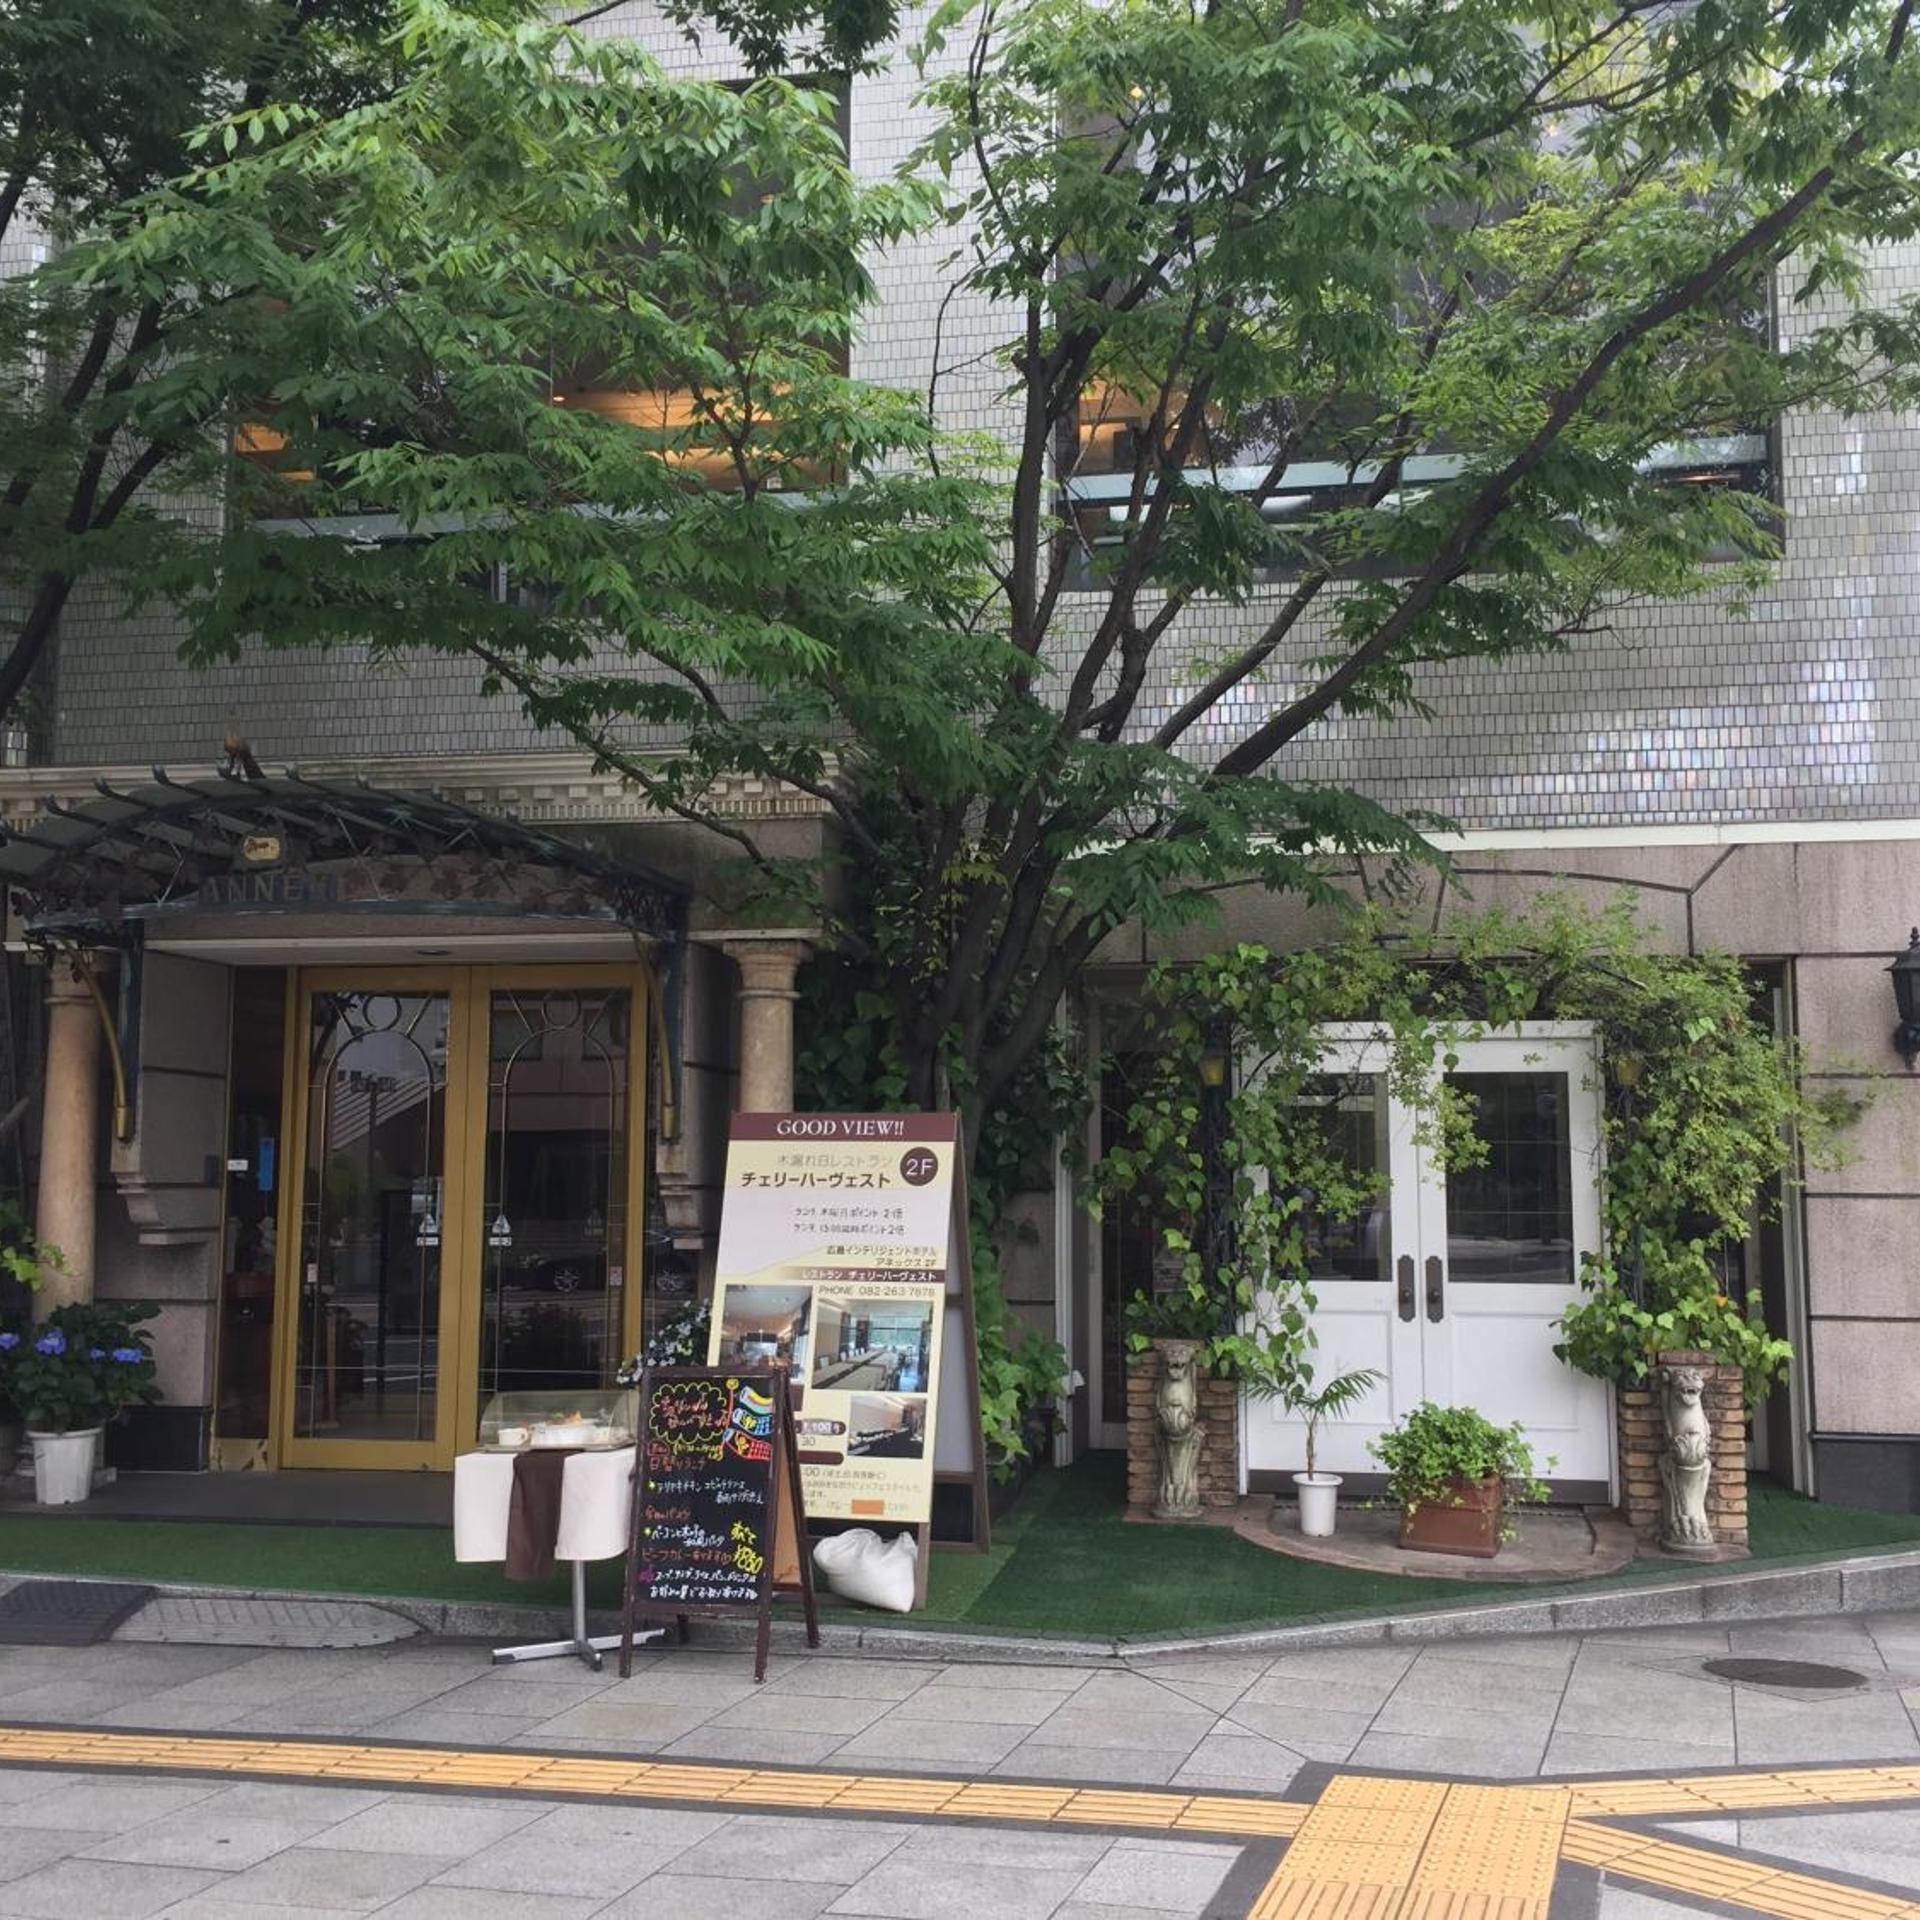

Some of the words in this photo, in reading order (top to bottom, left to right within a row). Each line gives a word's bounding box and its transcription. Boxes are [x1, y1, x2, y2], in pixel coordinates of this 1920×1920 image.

[777, 1119, 836, 1136] GOOD
[842, 1120, 905, 1136] VIEW!!
[905, 1158, 935, 1177] 2F
[741, 1172, 891, 1189] チェリーハーヴェスト
[849, 1271, 937, 1282] チェリーハーヴェスト
[819, 1285, 852, 1296] PHONE
